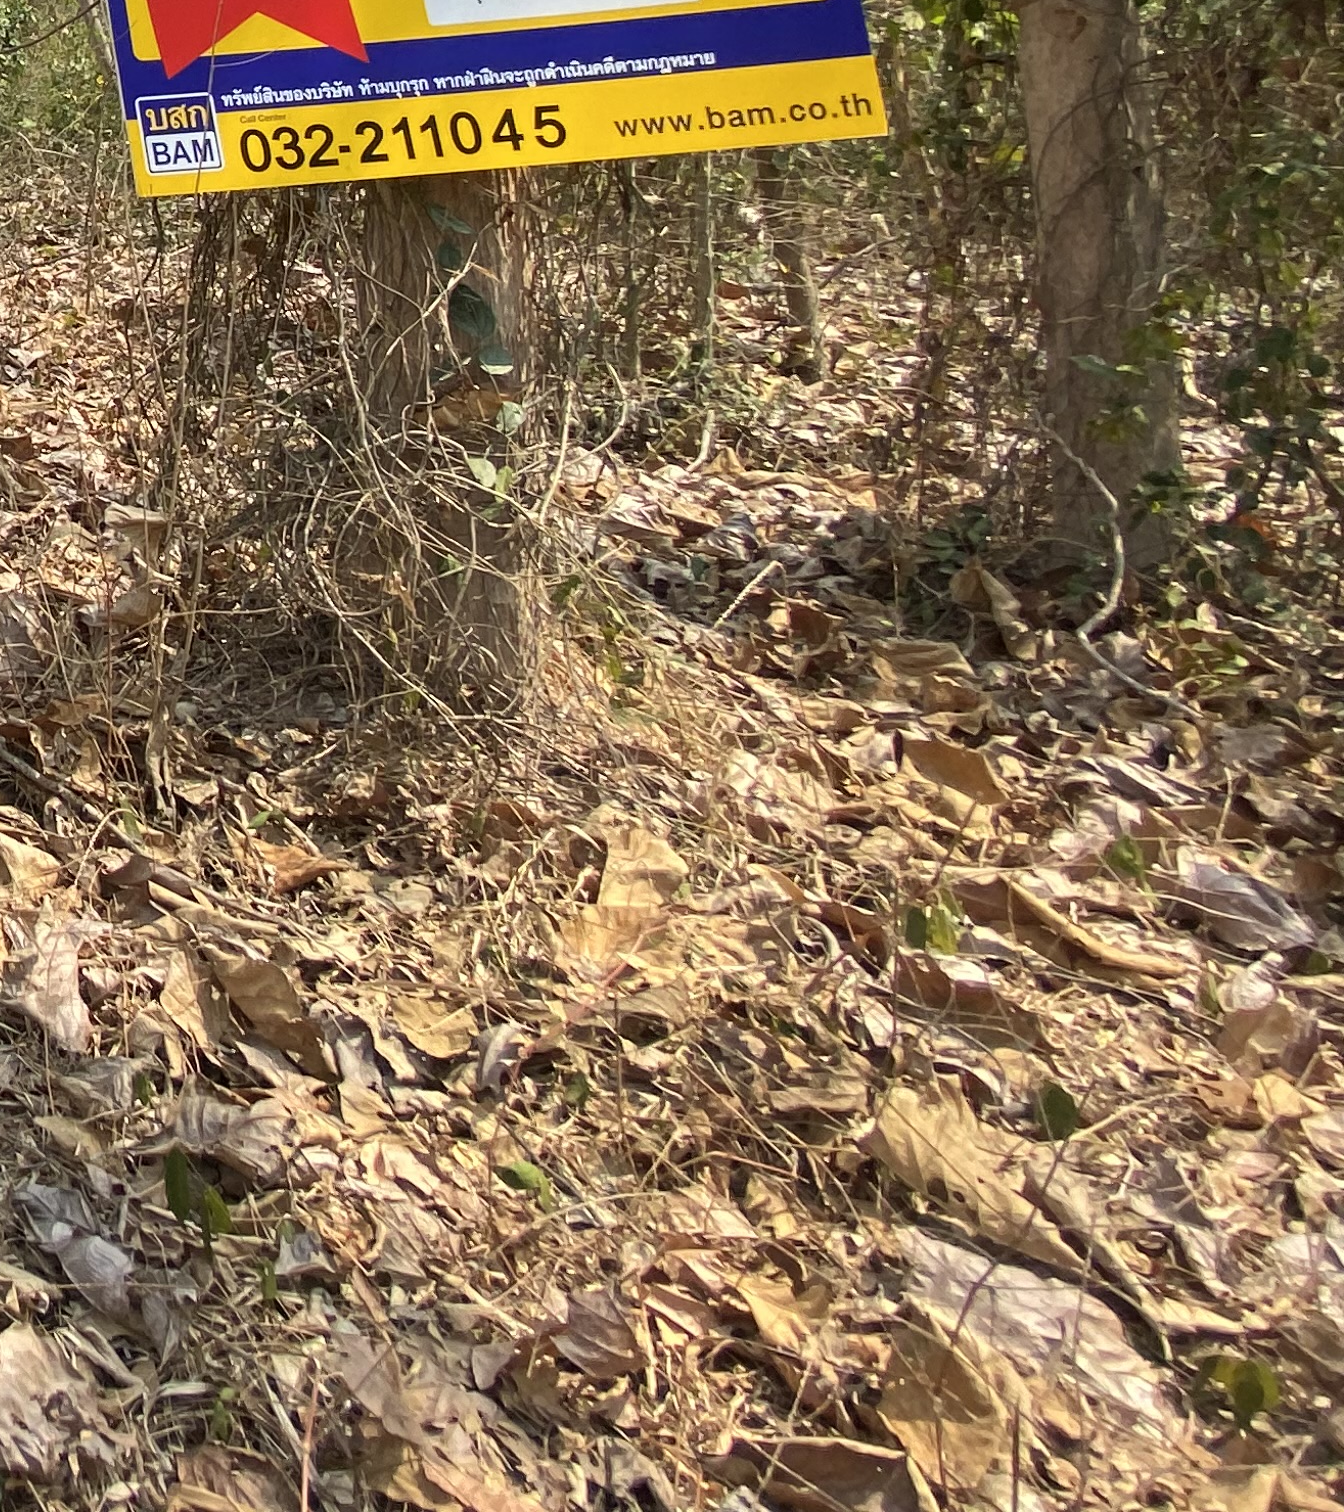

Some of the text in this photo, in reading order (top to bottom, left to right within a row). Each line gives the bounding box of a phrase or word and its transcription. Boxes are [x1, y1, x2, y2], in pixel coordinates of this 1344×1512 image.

[221, 80, 354, 107] ทรัพย์สินของบริษัท
[358, 78, 430, 99] ห้ามบุกรุก
[145, 103, 209, 132] บสก
[614, 93, 873, 138] www.bam.co.th
[151, 138, 215, 166] BAM
[240, 104, 567, 173] 032-211045
